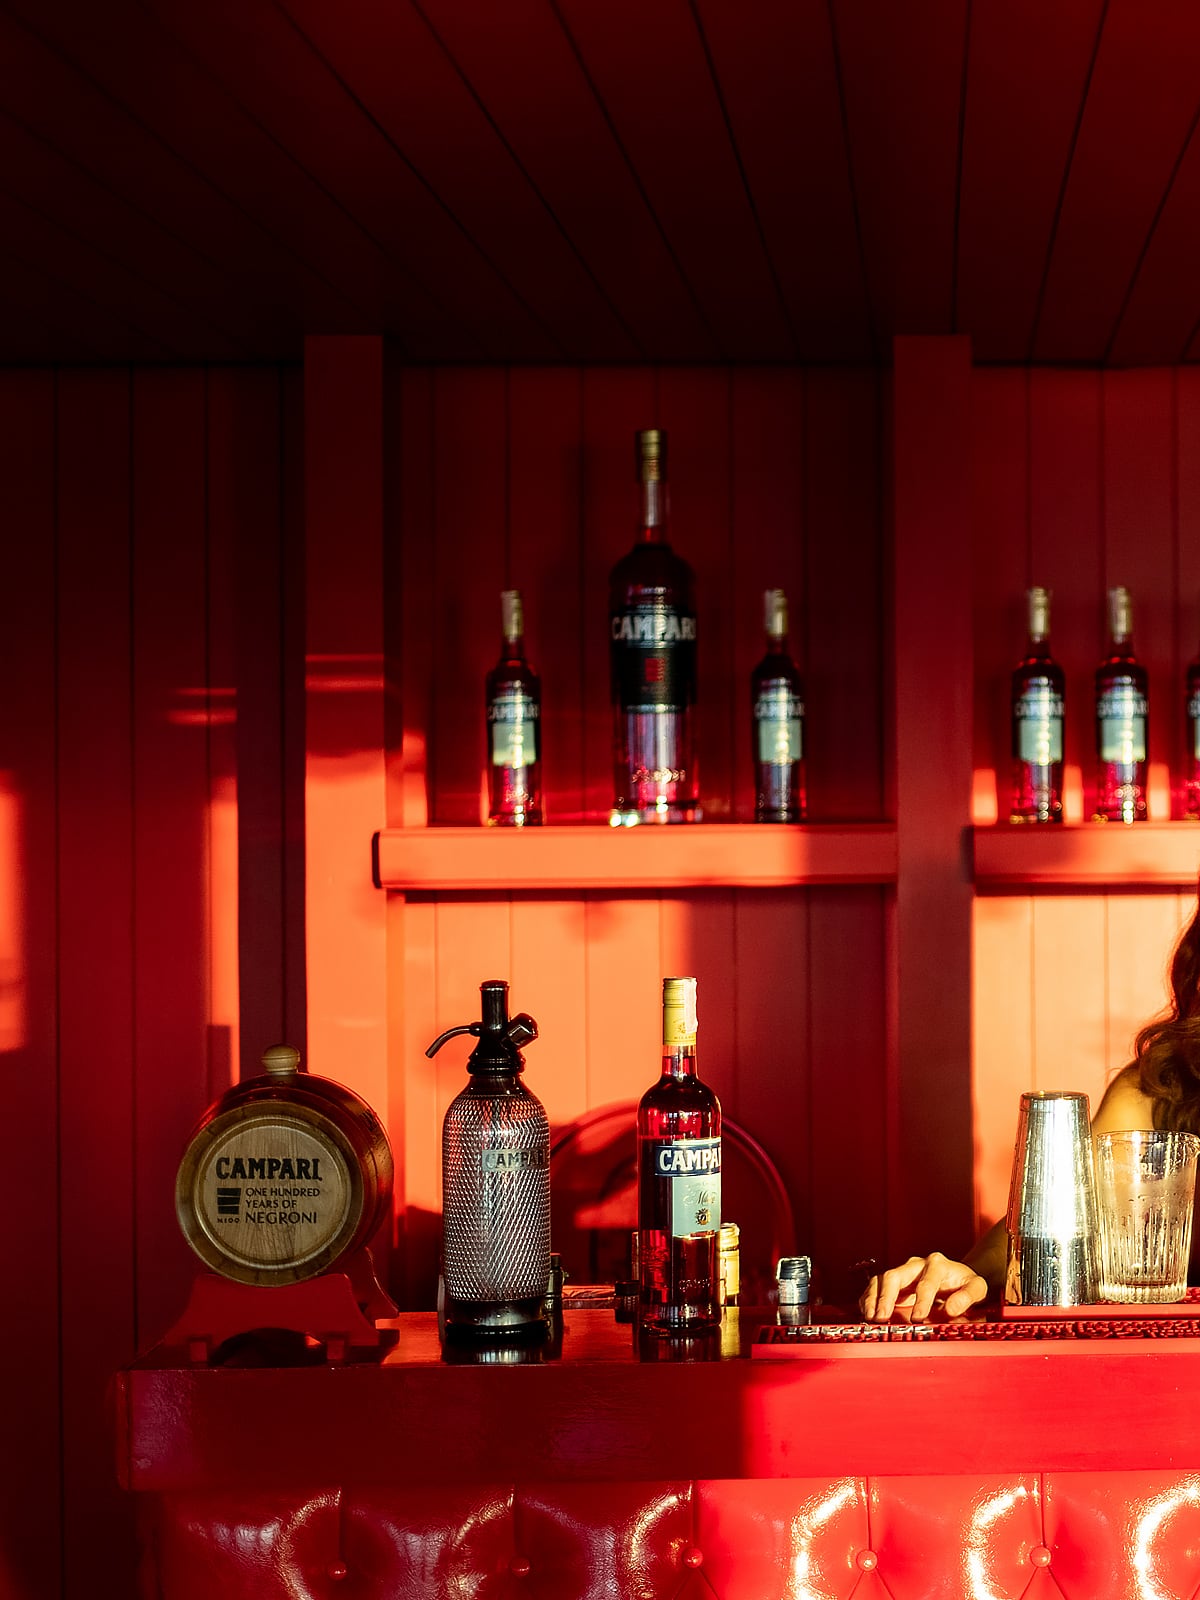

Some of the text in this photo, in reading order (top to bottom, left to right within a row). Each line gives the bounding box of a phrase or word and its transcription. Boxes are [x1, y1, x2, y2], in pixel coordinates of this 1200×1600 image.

[216, 1157, 322, 1181] CAMPARI
[246, 1187, 320, 1197] ONE HUNDRED
[246, 1199, 297, 1209] YEARS OF
[245, 1211, 317, 1225] NEGRONI
